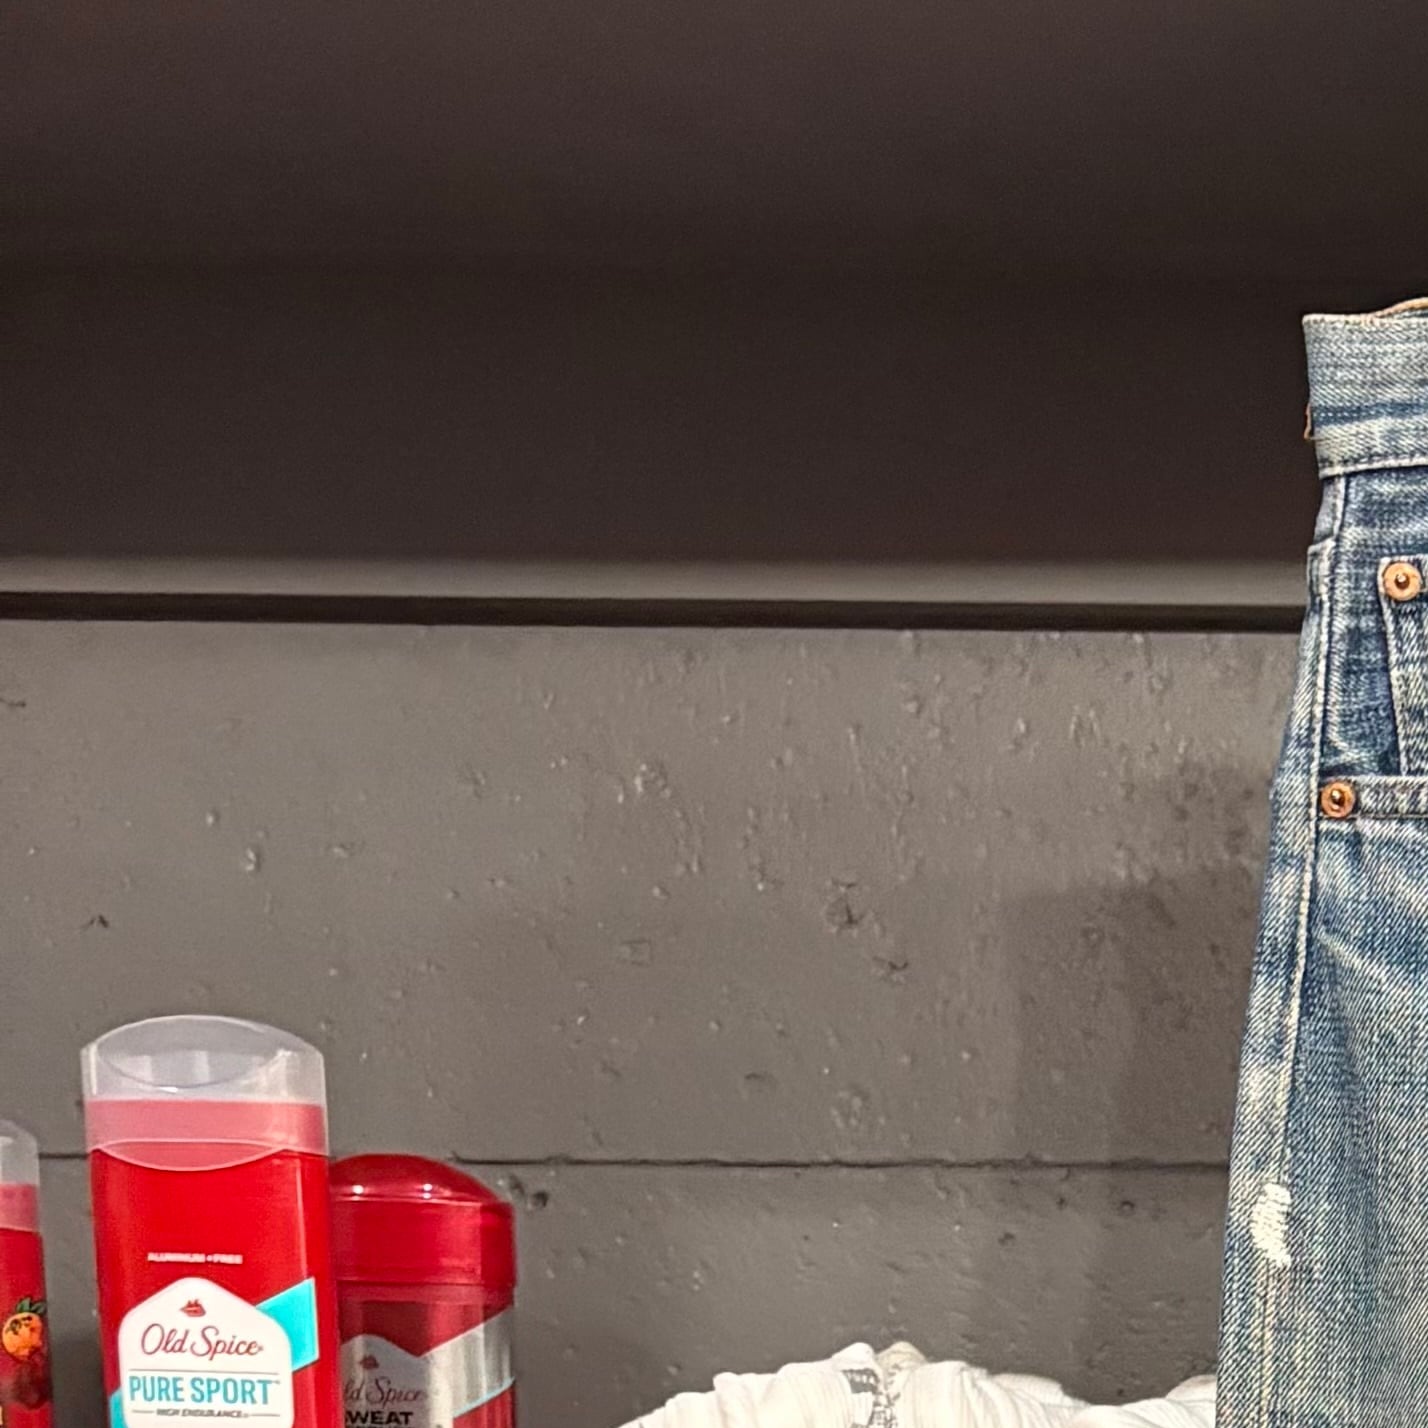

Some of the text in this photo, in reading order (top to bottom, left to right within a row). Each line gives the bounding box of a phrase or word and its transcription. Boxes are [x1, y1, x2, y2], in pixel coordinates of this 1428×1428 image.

[141, 1323, 261, 1361] Old Spice
[129, 1375, 272, 1405] PURE SPORT
